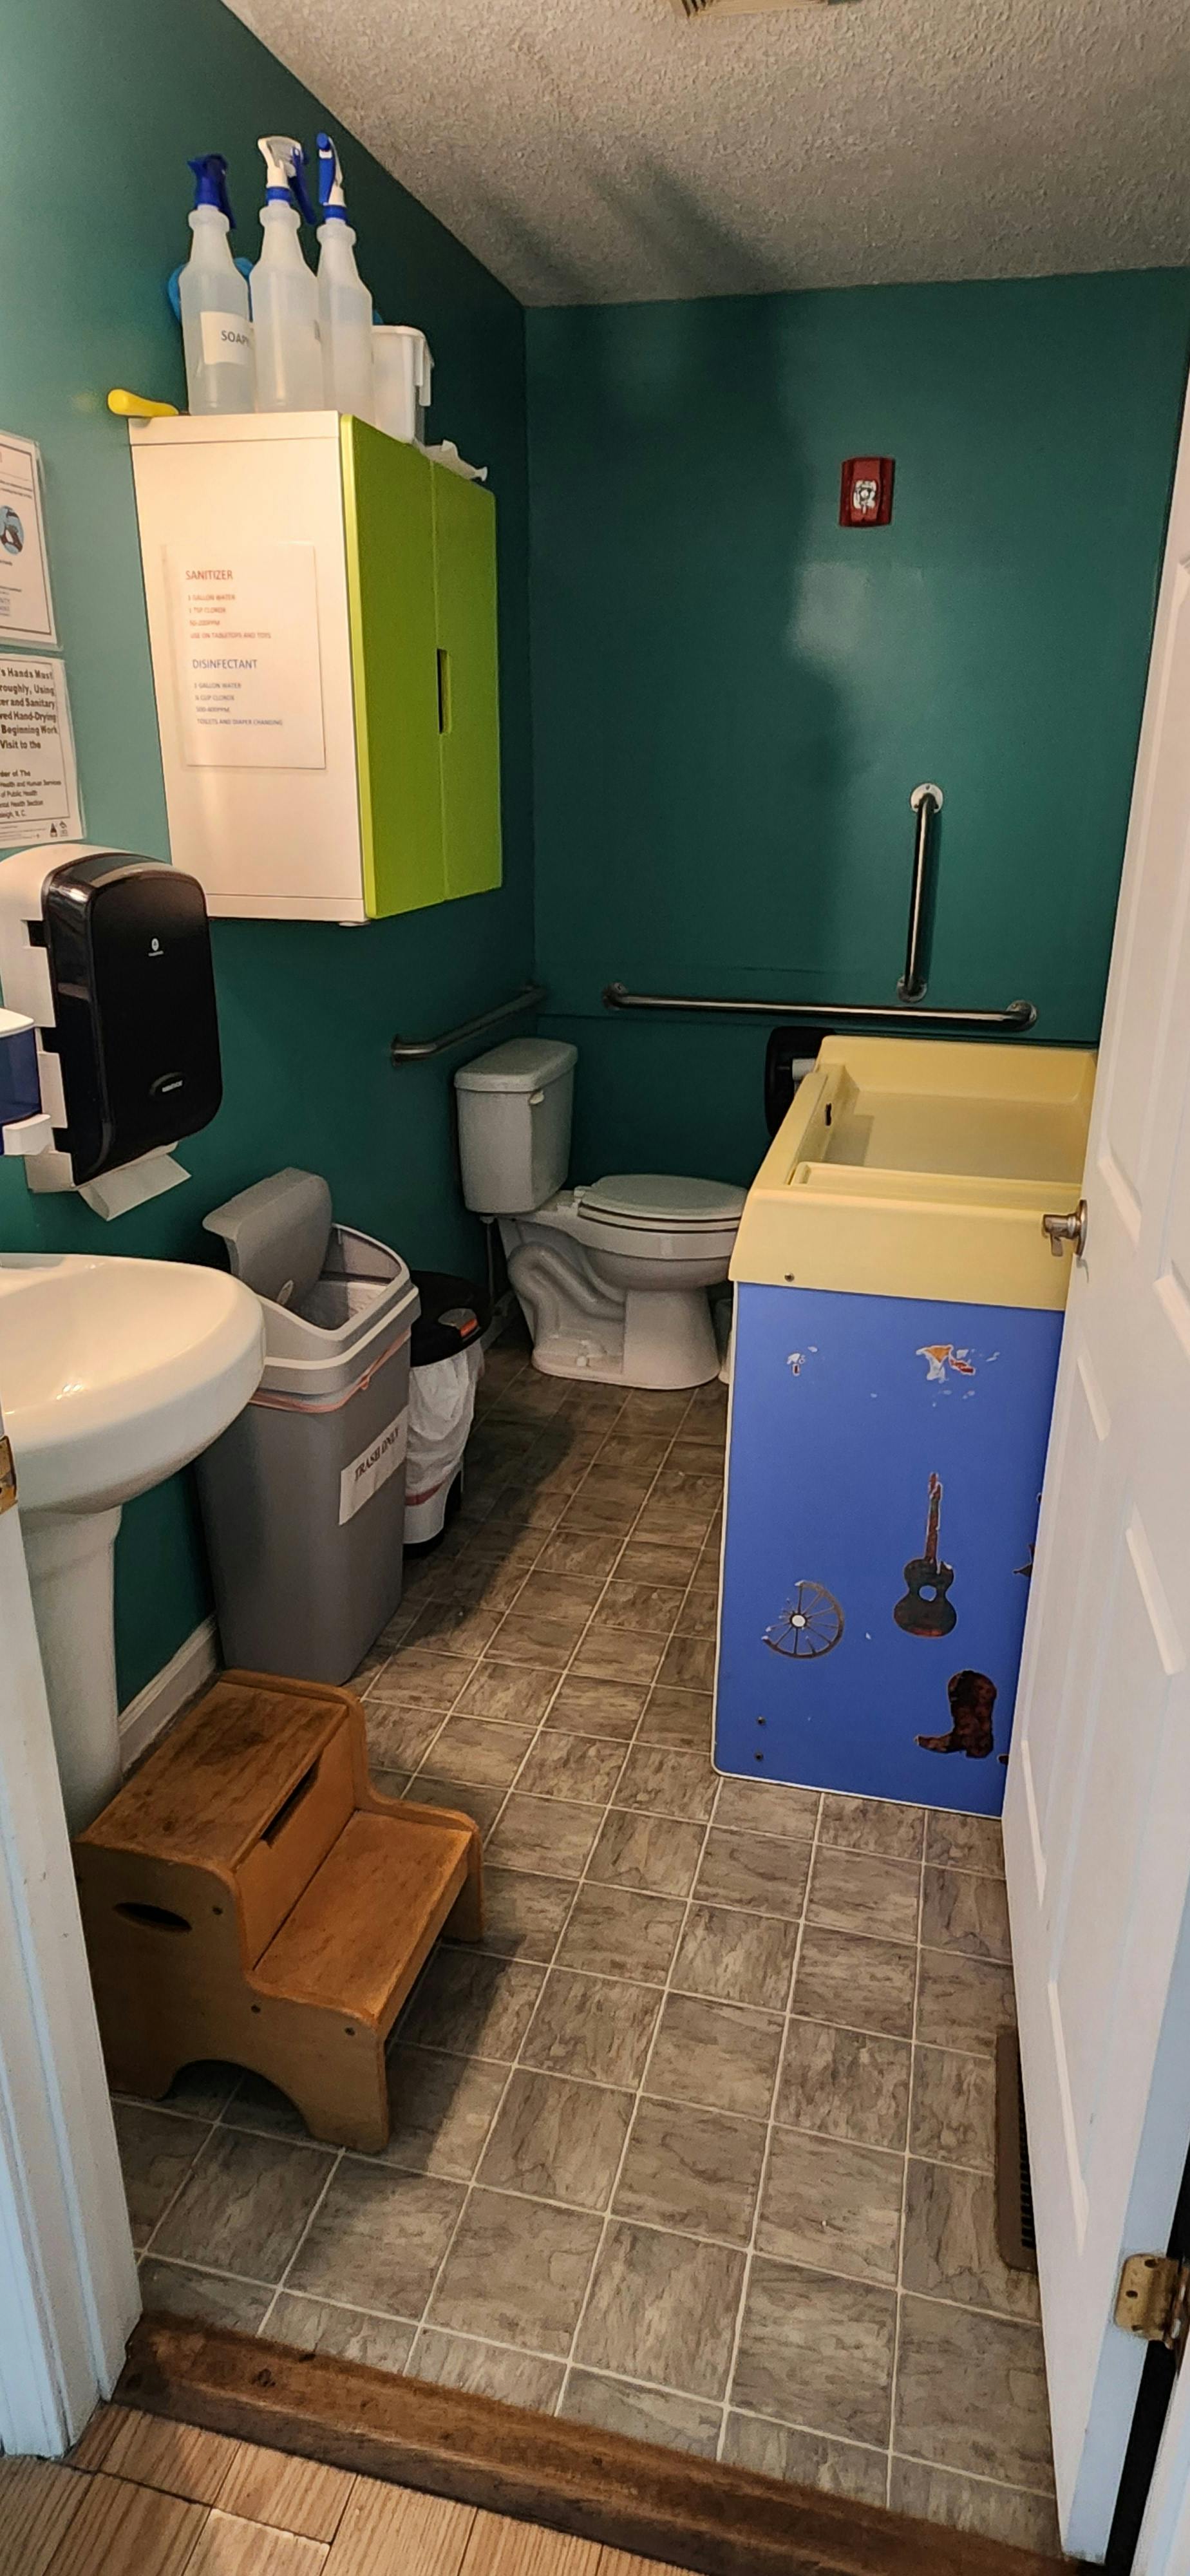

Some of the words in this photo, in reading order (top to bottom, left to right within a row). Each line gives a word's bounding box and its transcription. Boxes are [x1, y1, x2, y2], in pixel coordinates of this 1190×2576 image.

[185, 570, 233, 580] SANITIZER
[192, 659, 258, 669] DISINFECTANT
[7, 668, 33, 678] Hands
[35, 670, 53, 679] Must
[33, 684, 54, 696] Using
[10, 698, 24, 707] and
[25, 698, 55, 710] Sanitary
[1, 724, 39, 736] Beginning
[41, 726, 57, 734] Work
[0, 740, 18, 749] Visit
[20, 741, 27, 749] to
[29, 741, 41, 749] the
[355, 1446, 381, 1481] TRASH
[381, 1427, 399, 1454] ONLY
